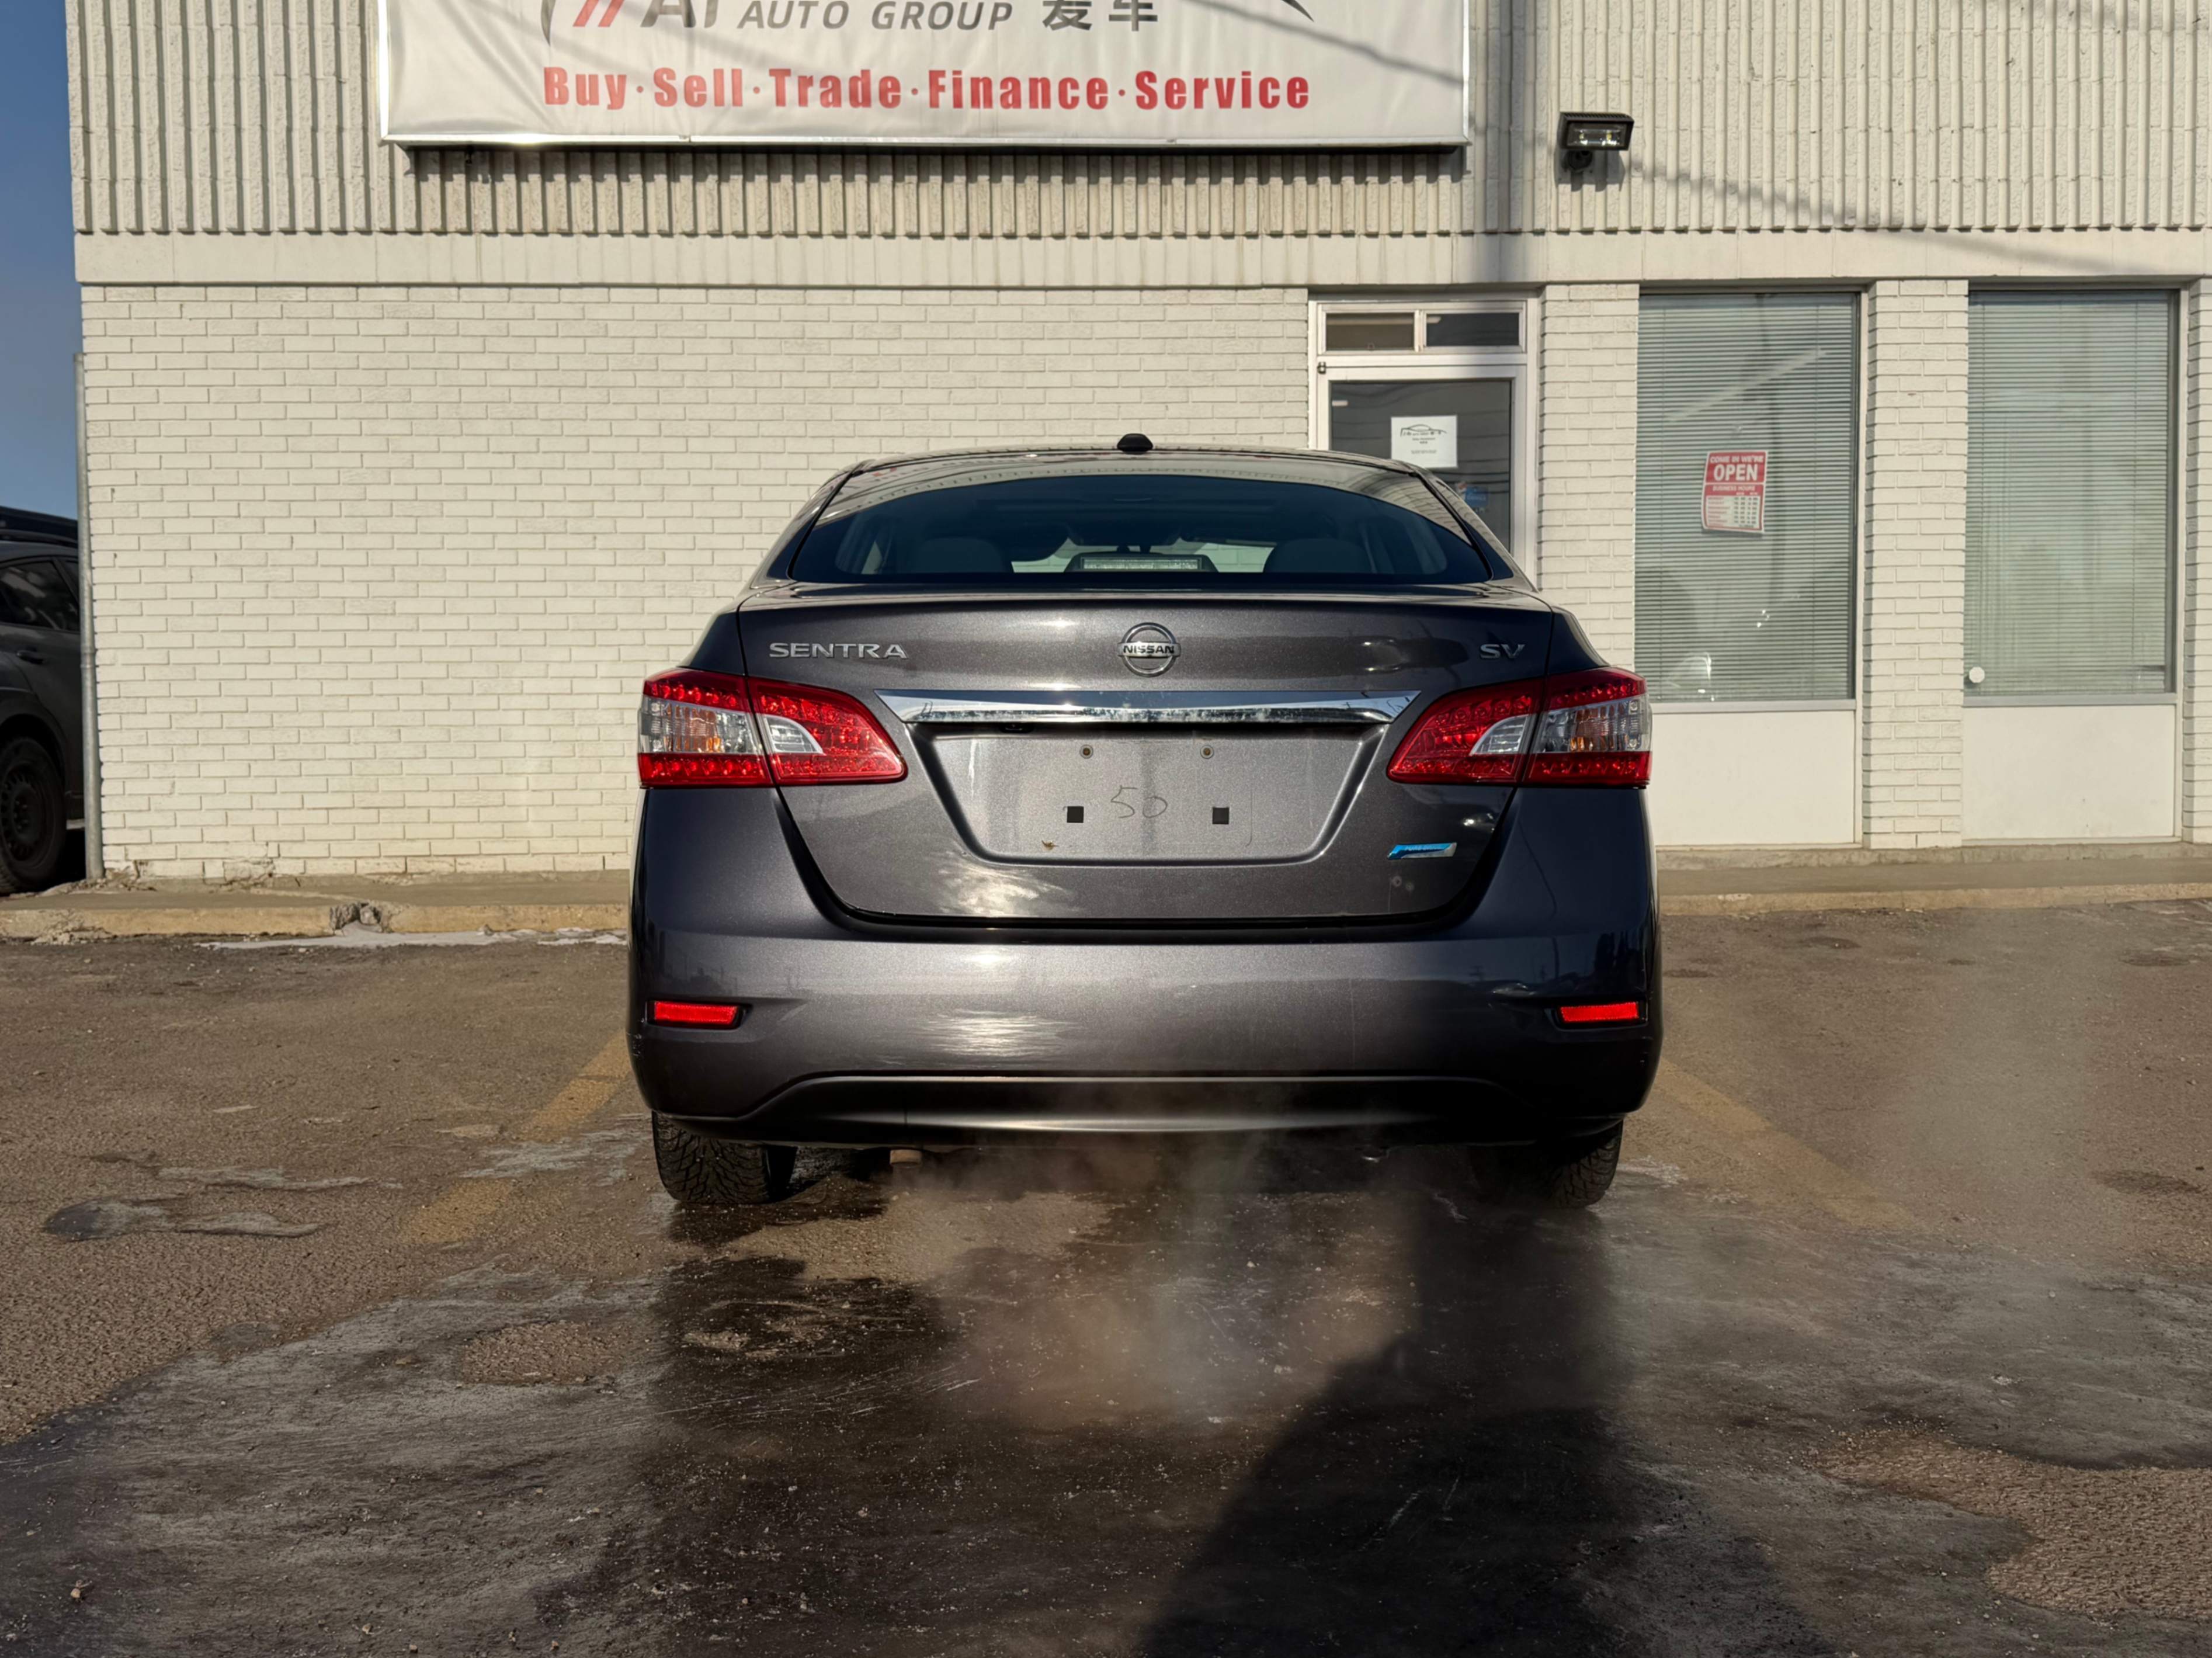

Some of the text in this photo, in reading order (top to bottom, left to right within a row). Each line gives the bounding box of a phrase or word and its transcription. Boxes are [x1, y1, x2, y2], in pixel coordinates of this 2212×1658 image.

[737, 1, 850, 29] AUTO
[871, 1, 1013, 30] GROUP
[543, 67, 1309, 110] Buy Sell Trade Finance Service
[1713, 464, 1758, 481] OPEN
[769, 642, 908, 659] SENTRA
[1123, 645, 1175, 654] NISSAN
[1480, 643, 1525, 659] SV
